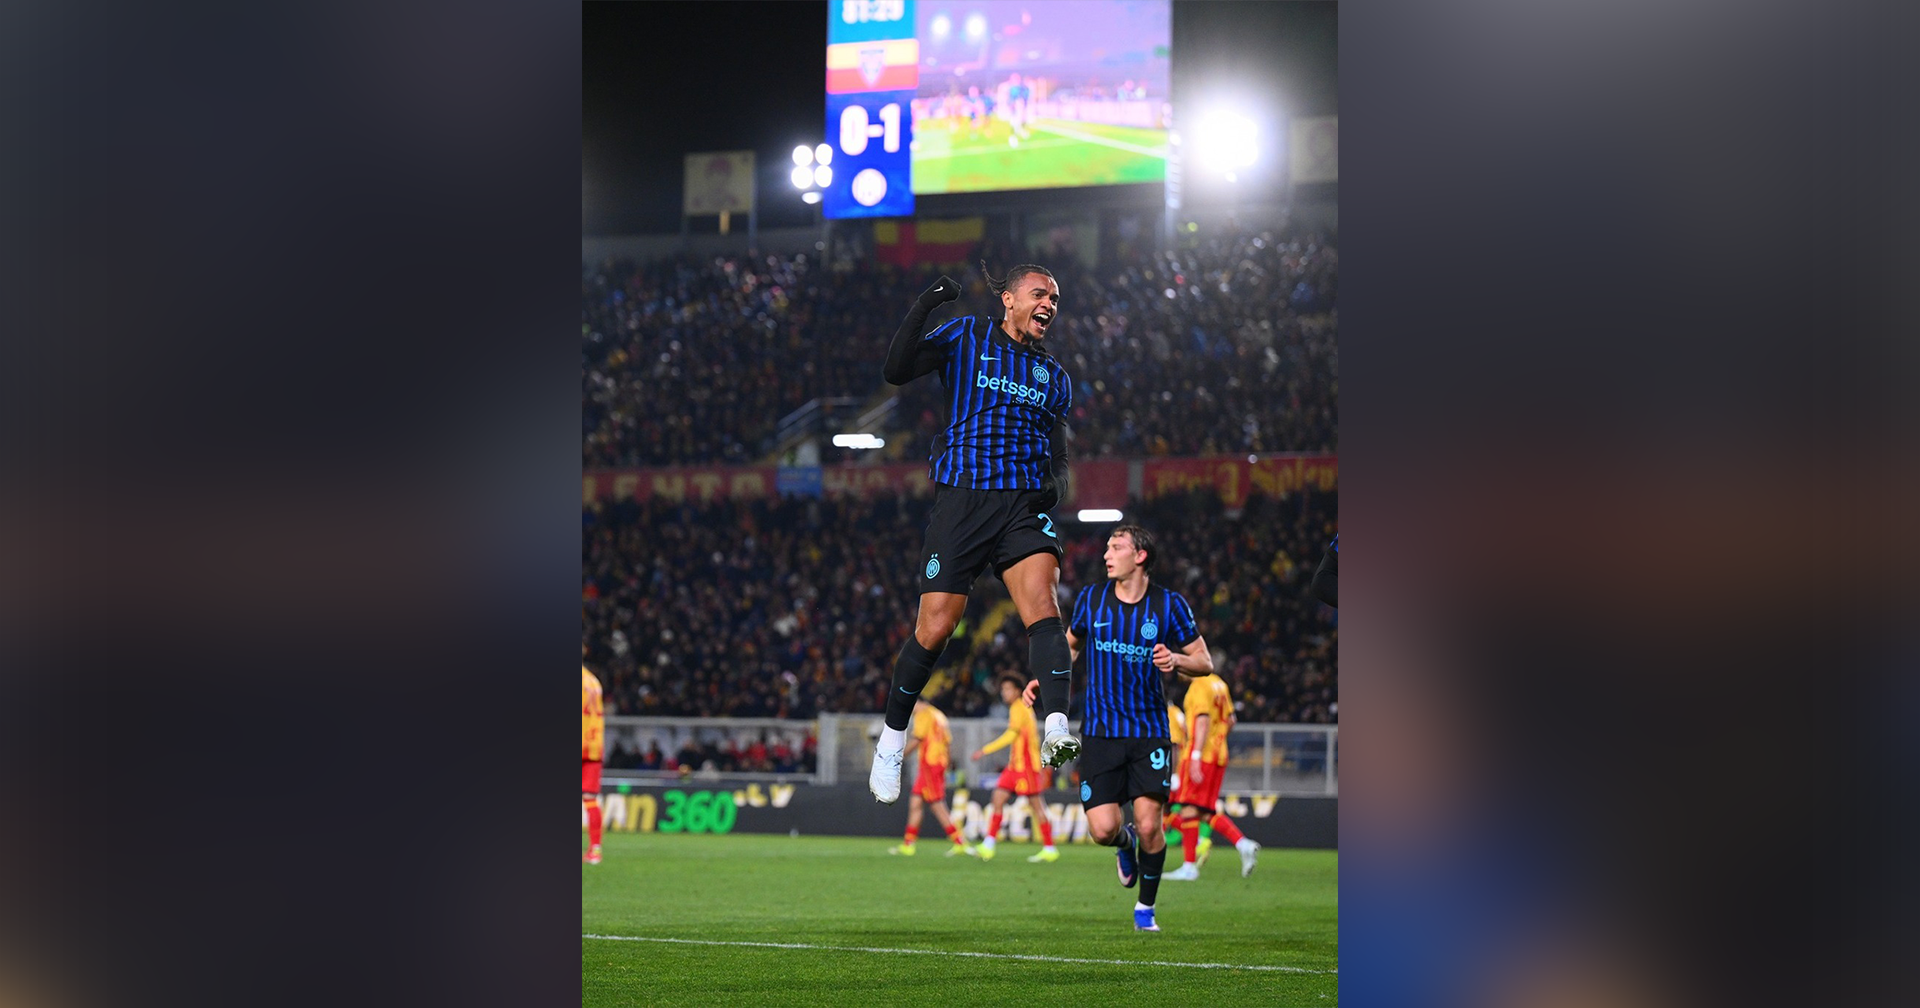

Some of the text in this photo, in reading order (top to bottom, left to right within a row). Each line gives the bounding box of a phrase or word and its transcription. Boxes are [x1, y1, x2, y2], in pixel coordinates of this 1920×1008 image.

[840, 103, 901, 155] 0-1
[976, 370, 1047, 406] betsson
[1094, 637, 1154, 657] betsson
[1150, 747, 1171, 770] 9
